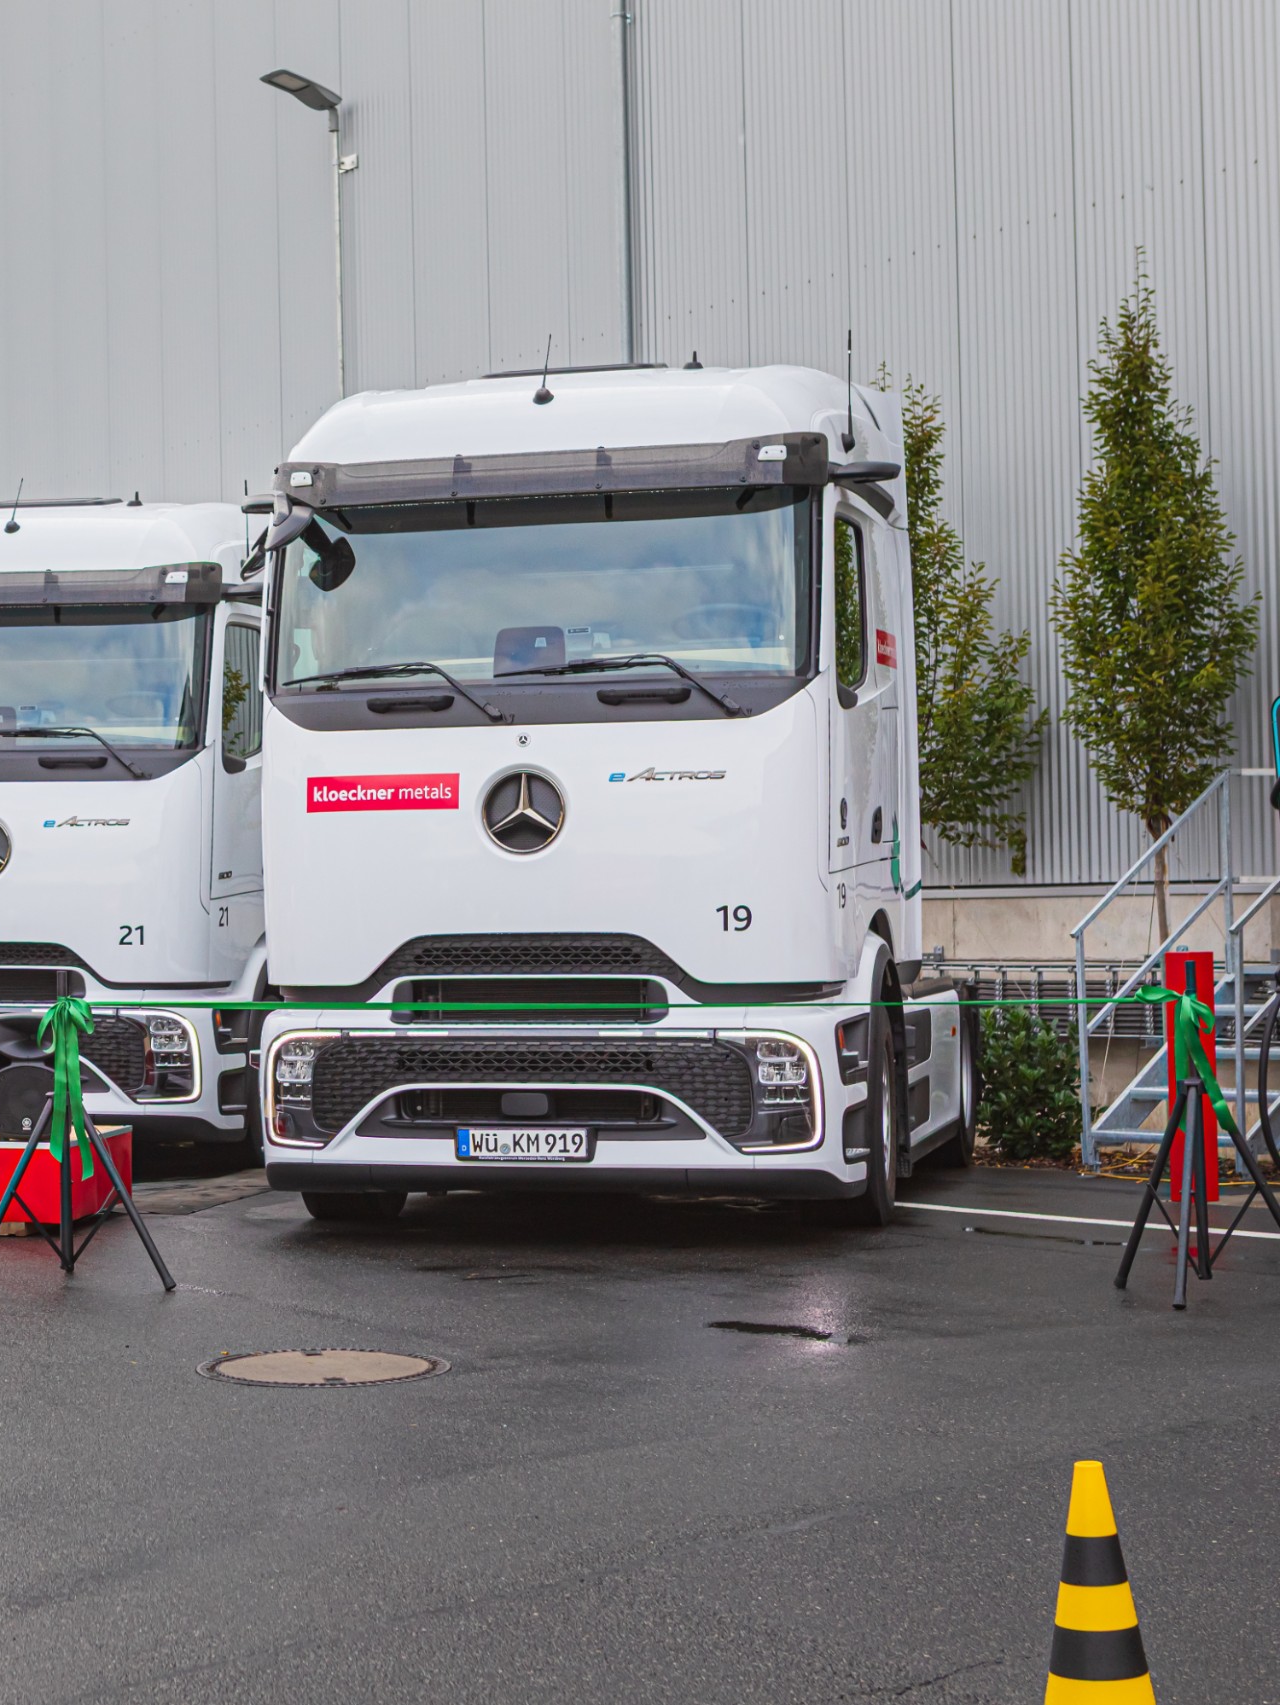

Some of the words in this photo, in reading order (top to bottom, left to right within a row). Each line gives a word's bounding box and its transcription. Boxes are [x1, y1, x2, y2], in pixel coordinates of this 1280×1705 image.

[313, 785, 395, 803] kloeckner
[398, 783, 452, 800] metals
[836, 882, 847, 909] 19
[218, 906, 229, 927] 21
[715, 904, 753, 932] 19
[118, 925, 145, 946] 21
[512, 1133, 540, 1153] KM
[544, 1133, 585, 1154] 919
